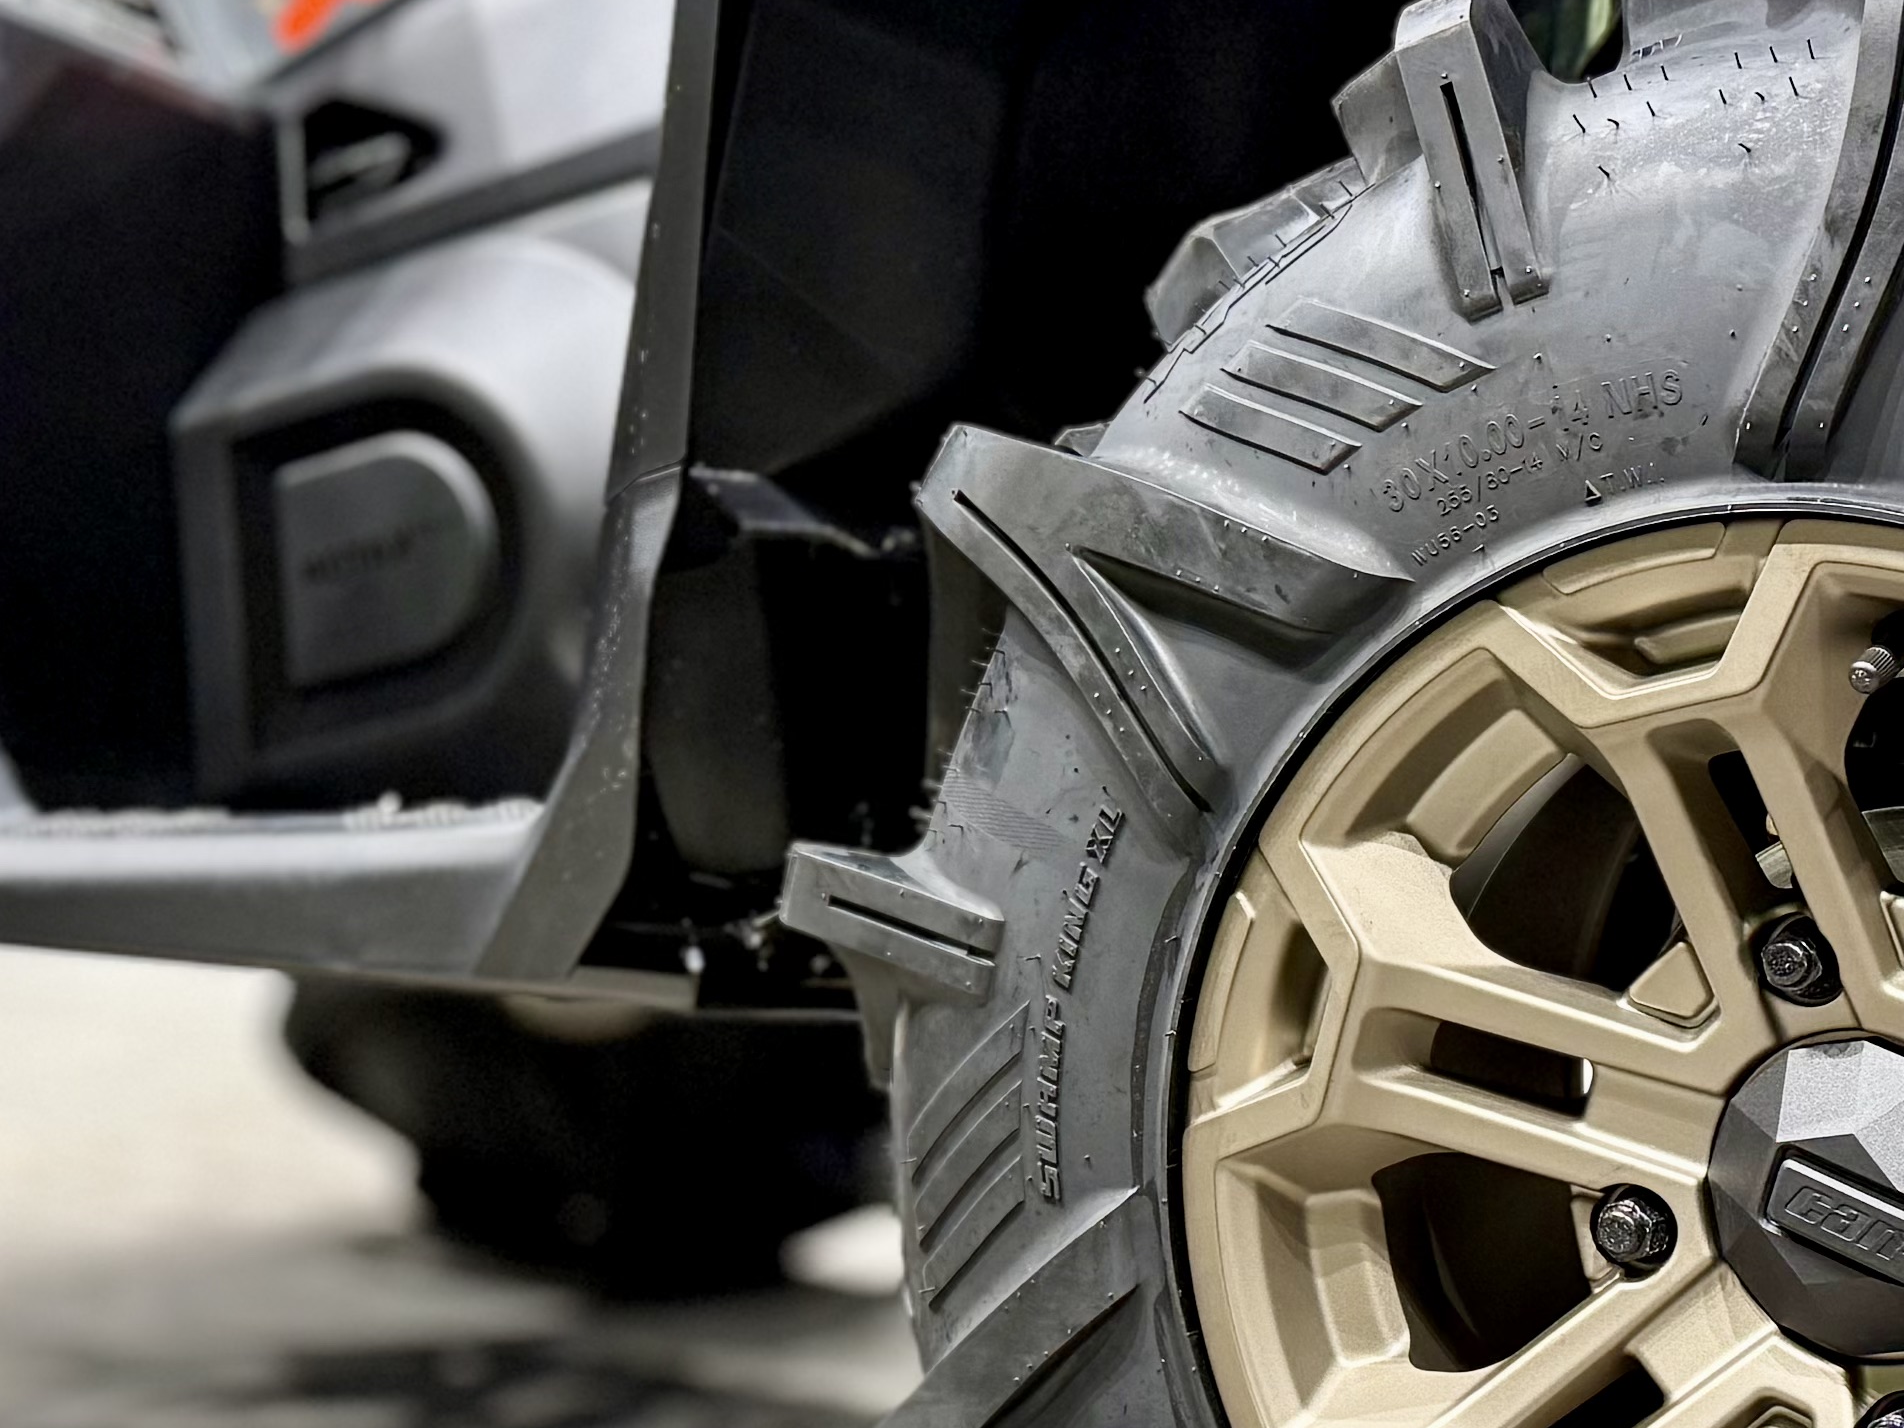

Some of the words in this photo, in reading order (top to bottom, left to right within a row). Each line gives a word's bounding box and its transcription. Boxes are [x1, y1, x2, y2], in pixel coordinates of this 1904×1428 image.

[1599, 366, 1684, 419] NHS
[1052, 860, 1097, 989] KING
[1085, 802, 1123, 864] XL
